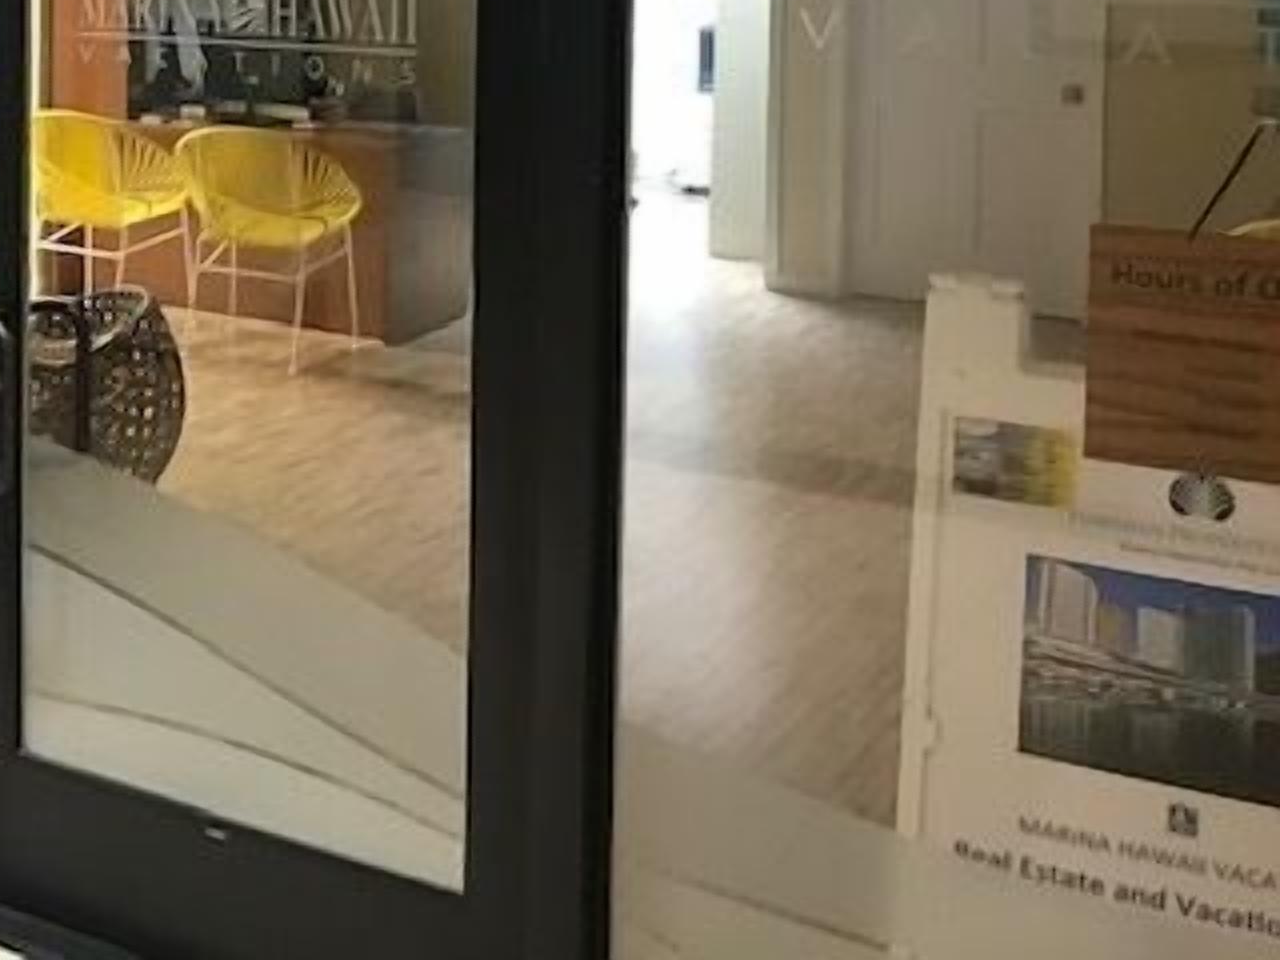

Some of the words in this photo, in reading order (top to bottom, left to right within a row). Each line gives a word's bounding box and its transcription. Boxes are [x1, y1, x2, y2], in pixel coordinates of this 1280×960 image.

[953, 839, 1012, 871] Real
[1019, 855, 1106, 896] Estate
[1114, 882, 1166, 911] and
[1017, 814, 1112, 852] MARINA
[1118, 839, 1208, 876] HAWAII
